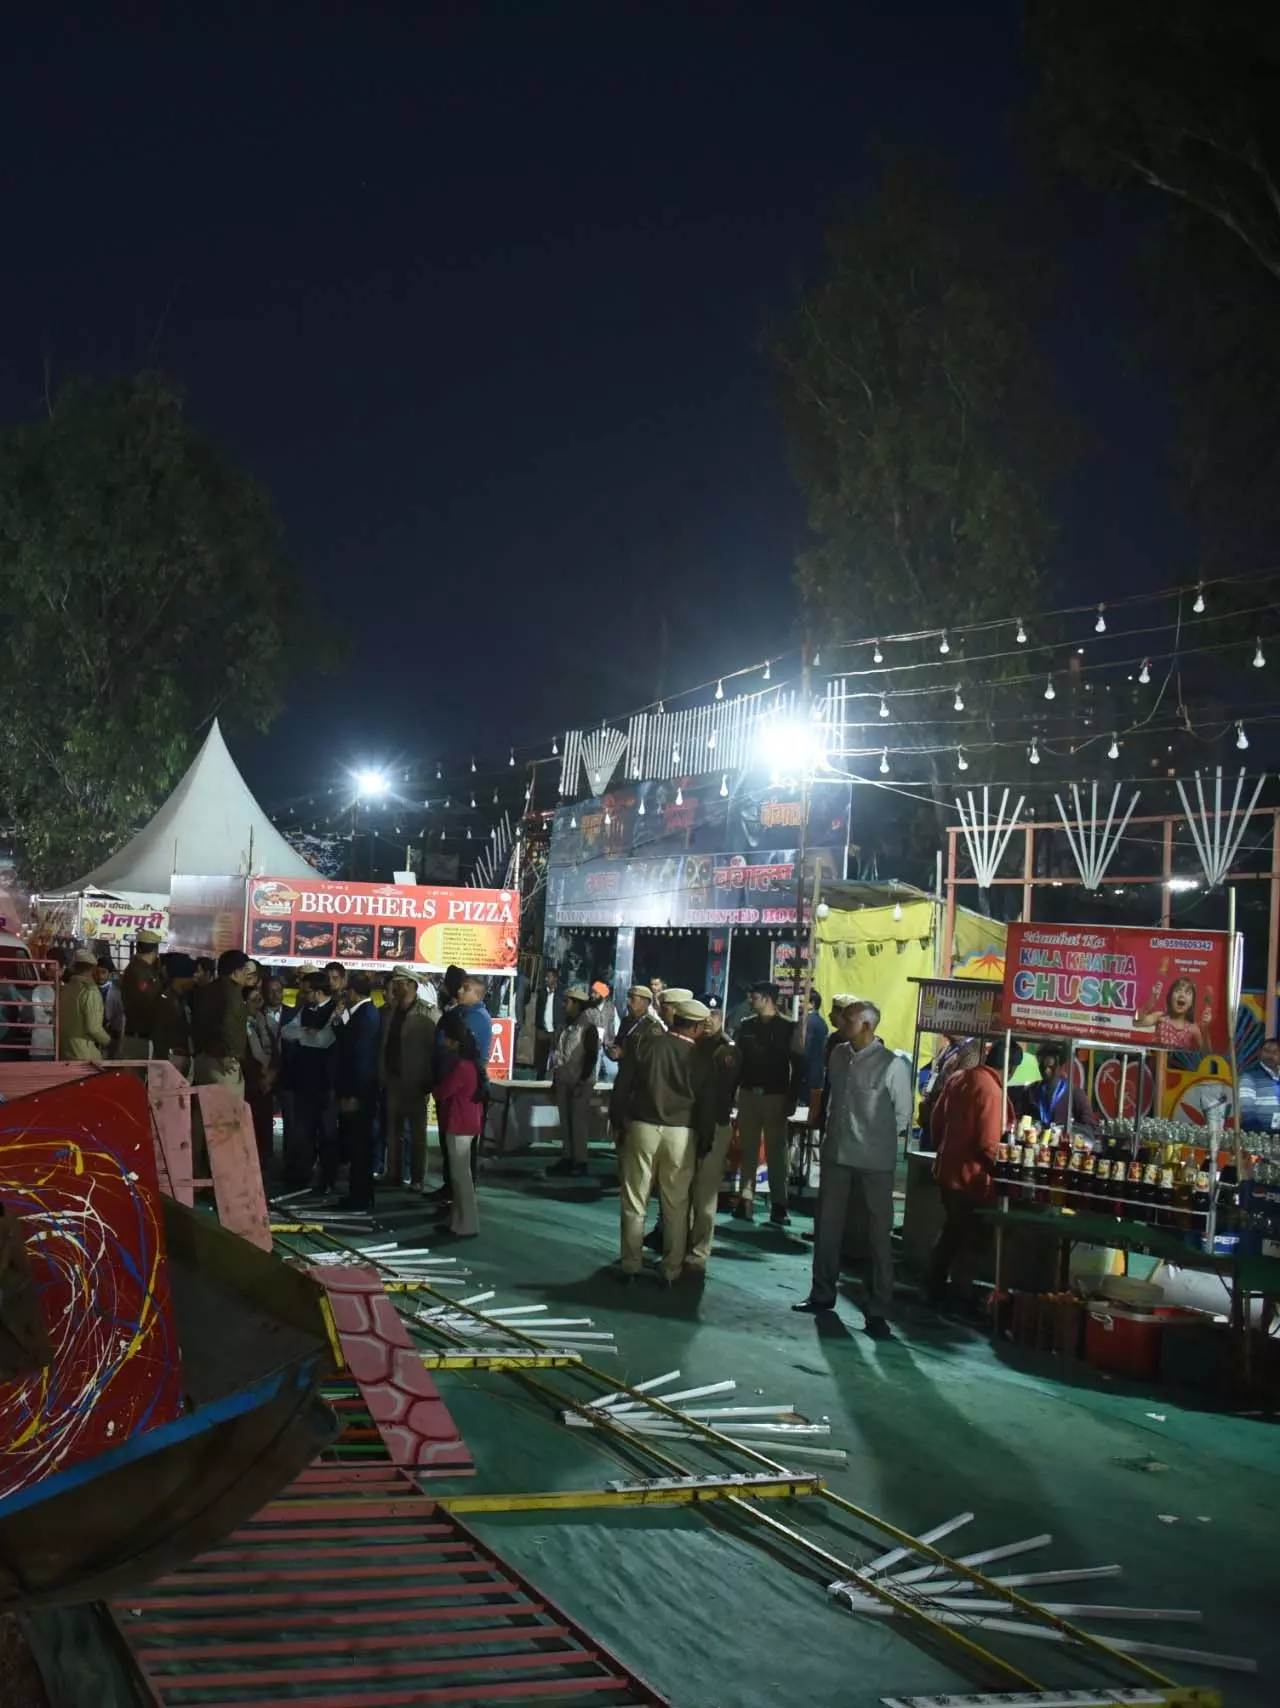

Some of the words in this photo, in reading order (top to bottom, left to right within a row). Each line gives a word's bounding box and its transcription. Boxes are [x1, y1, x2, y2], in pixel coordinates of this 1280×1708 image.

[300, 892, 437, 920] BROTHER.S
[447, 900, 514, 923] PIZZA
[1019, 947, 1064, 969] KALA
[1065, 951, 1137, 976] KHATTA
[1013, 970, 1137, 1011] CHUSKI
